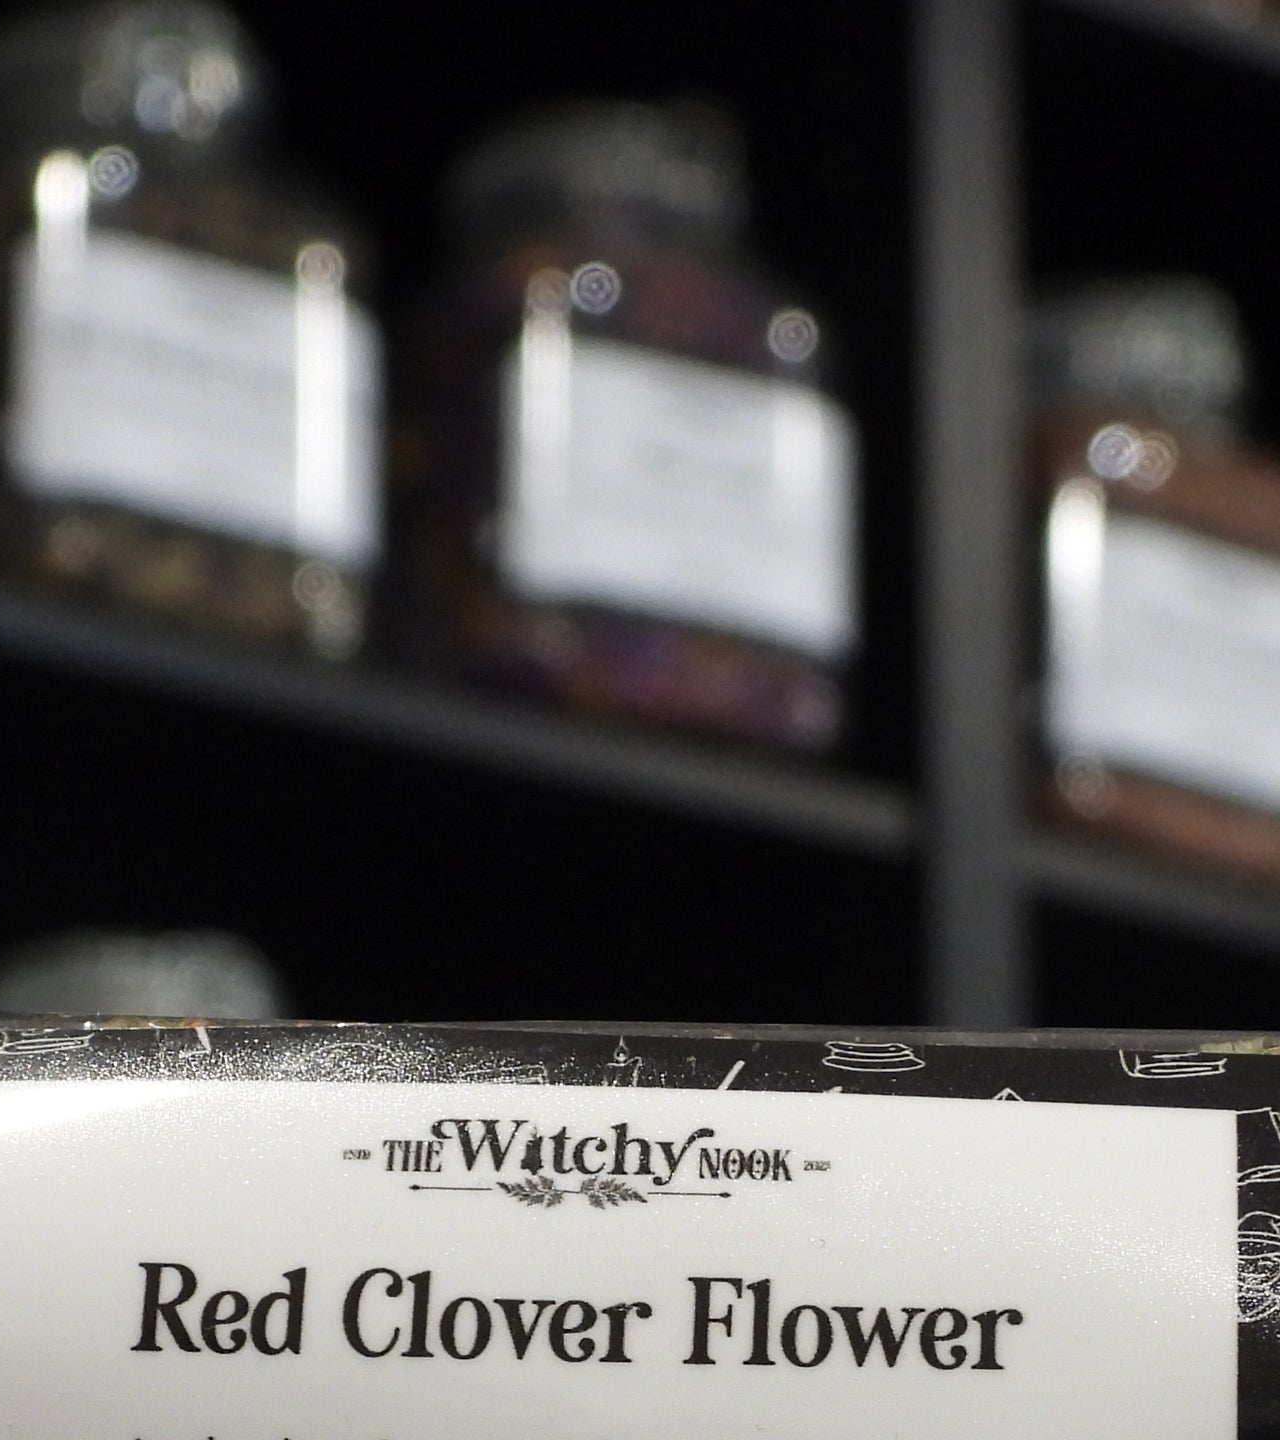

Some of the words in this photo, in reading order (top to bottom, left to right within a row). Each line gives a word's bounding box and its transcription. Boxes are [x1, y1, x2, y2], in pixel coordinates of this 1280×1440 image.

[382, 1139, 444, 1173] THE
[430, 1118, 716, 1187] Witchy
[698, 1147, 793, 1182] NOOK
[129, 1262, 308, 1359] Red
[341, 1267, 652, 1365] Clover
[682, 1276, 1024, 1371] Flower
